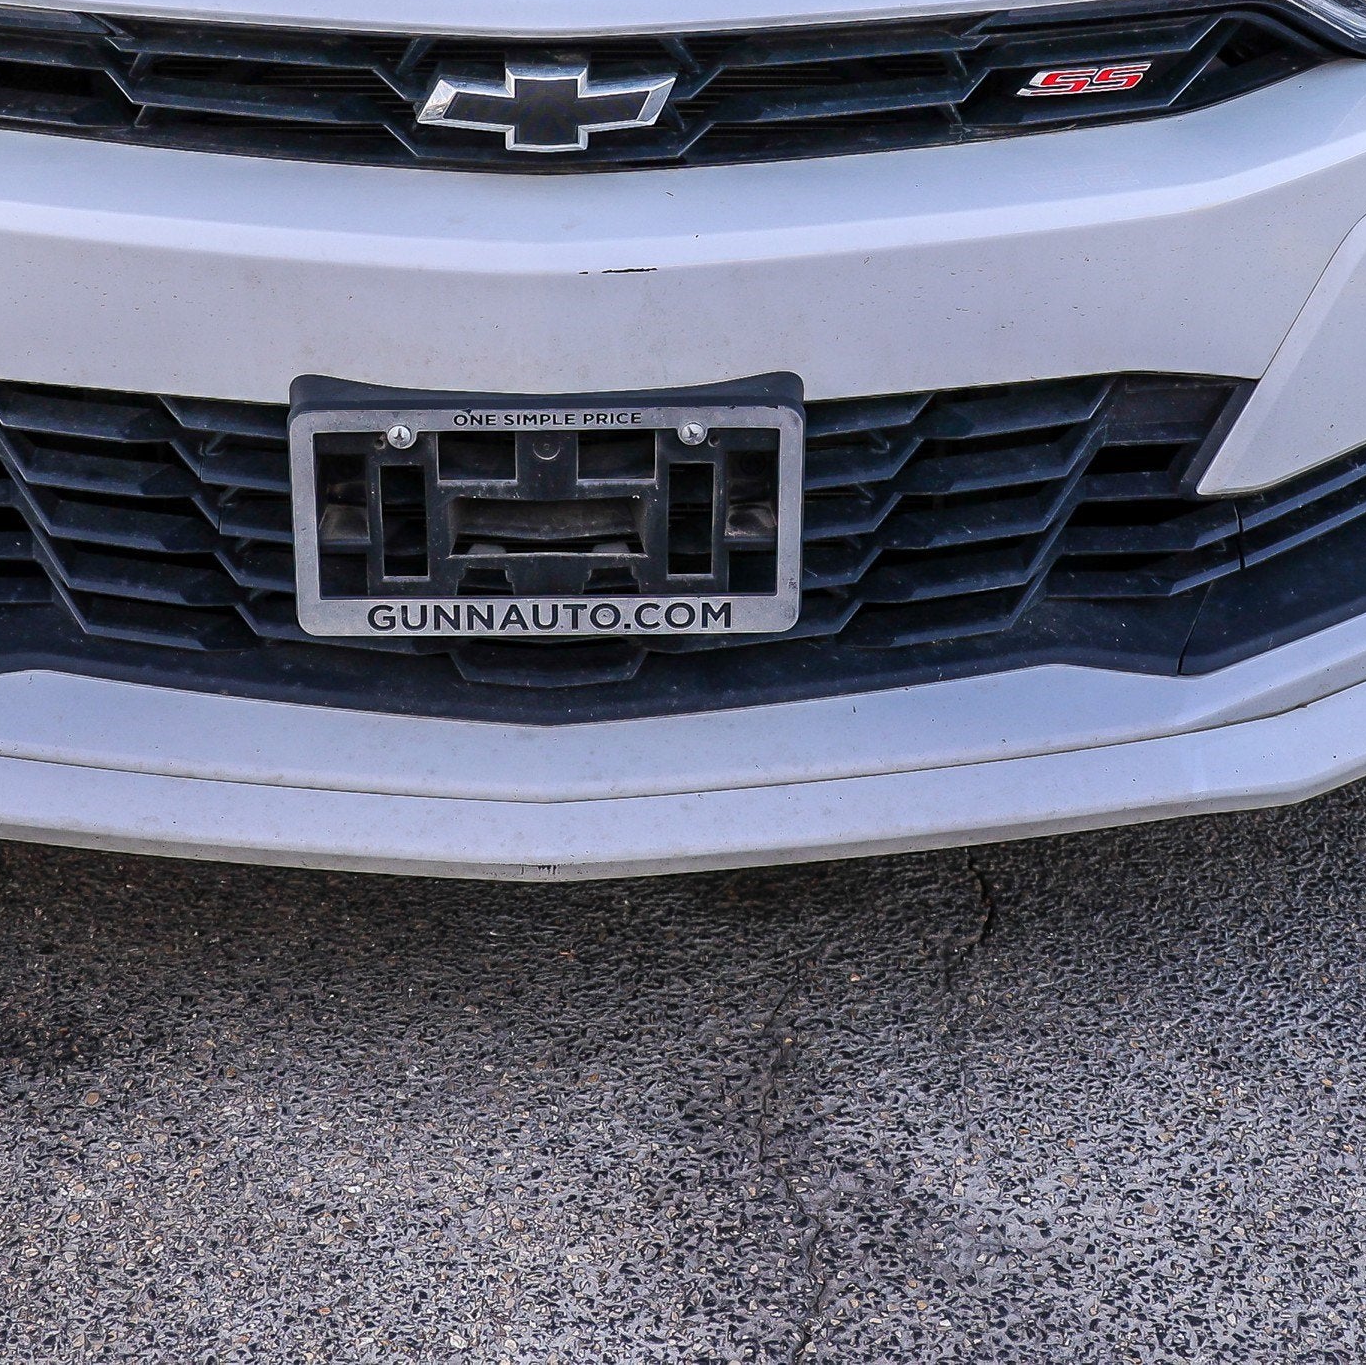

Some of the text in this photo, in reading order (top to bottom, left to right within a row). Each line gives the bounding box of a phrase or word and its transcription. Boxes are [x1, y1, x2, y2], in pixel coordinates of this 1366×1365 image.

[1016, 62, 1152, 97] SS
[453, 412, 642, 427] ONE SIMPLE PRICE
[367, 601, 732, 632] GUNNAUTO.COM
